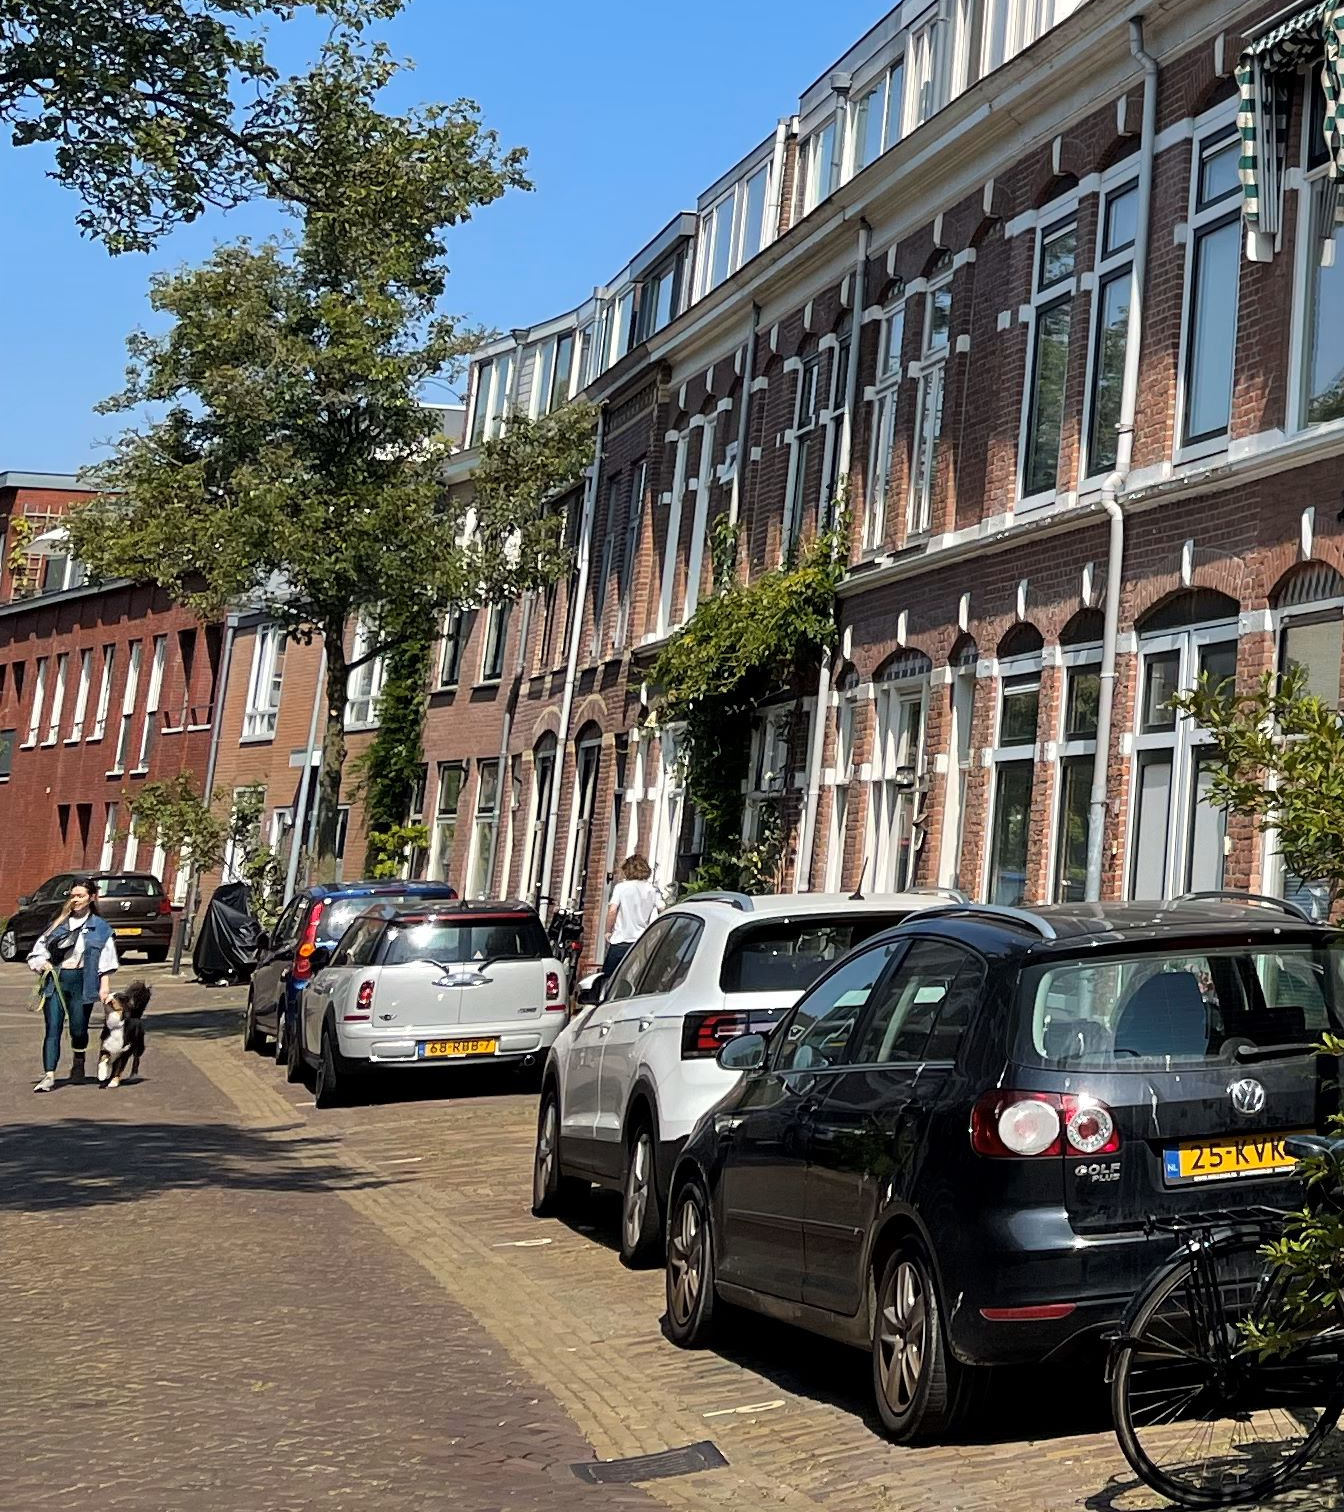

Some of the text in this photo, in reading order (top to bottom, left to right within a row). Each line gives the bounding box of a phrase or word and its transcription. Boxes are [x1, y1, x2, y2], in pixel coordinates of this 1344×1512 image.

[1191, 1136, 1286, 1171] 25-KVK
[1075, 1162, 1120, 1176] GOLF
[1167, 1163, 1178, 1172] NL
[1091, 1173, 1120, 1182] PLUS
